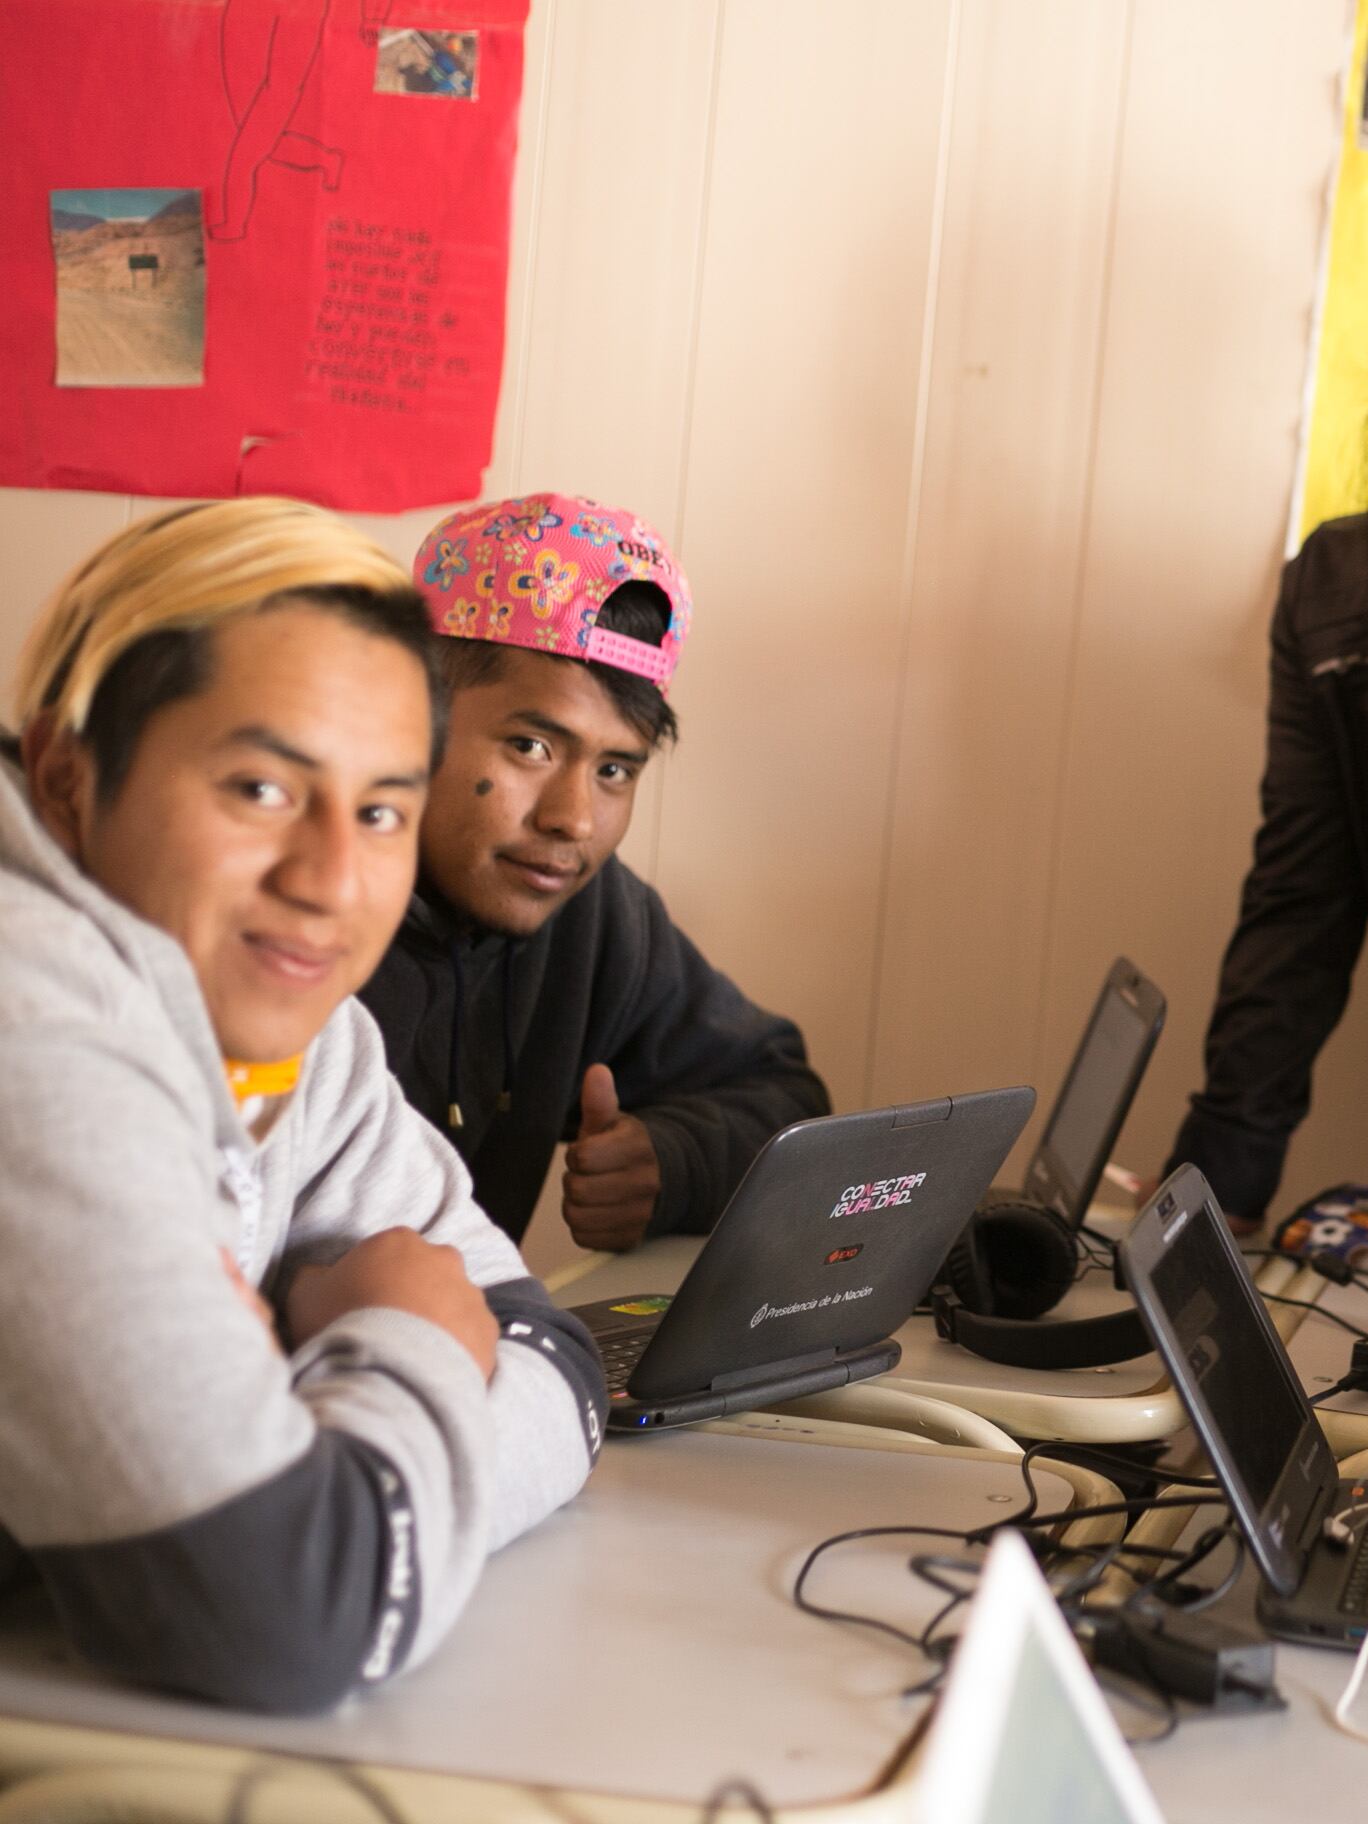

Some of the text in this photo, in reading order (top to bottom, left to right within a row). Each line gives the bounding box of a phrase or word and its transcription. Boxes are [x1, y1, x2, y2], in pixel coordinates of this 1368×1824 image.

[840, 1172, 927, 1202] CONECTAR
[765, 1286, 873, 1320] Presidencia de la Nación
